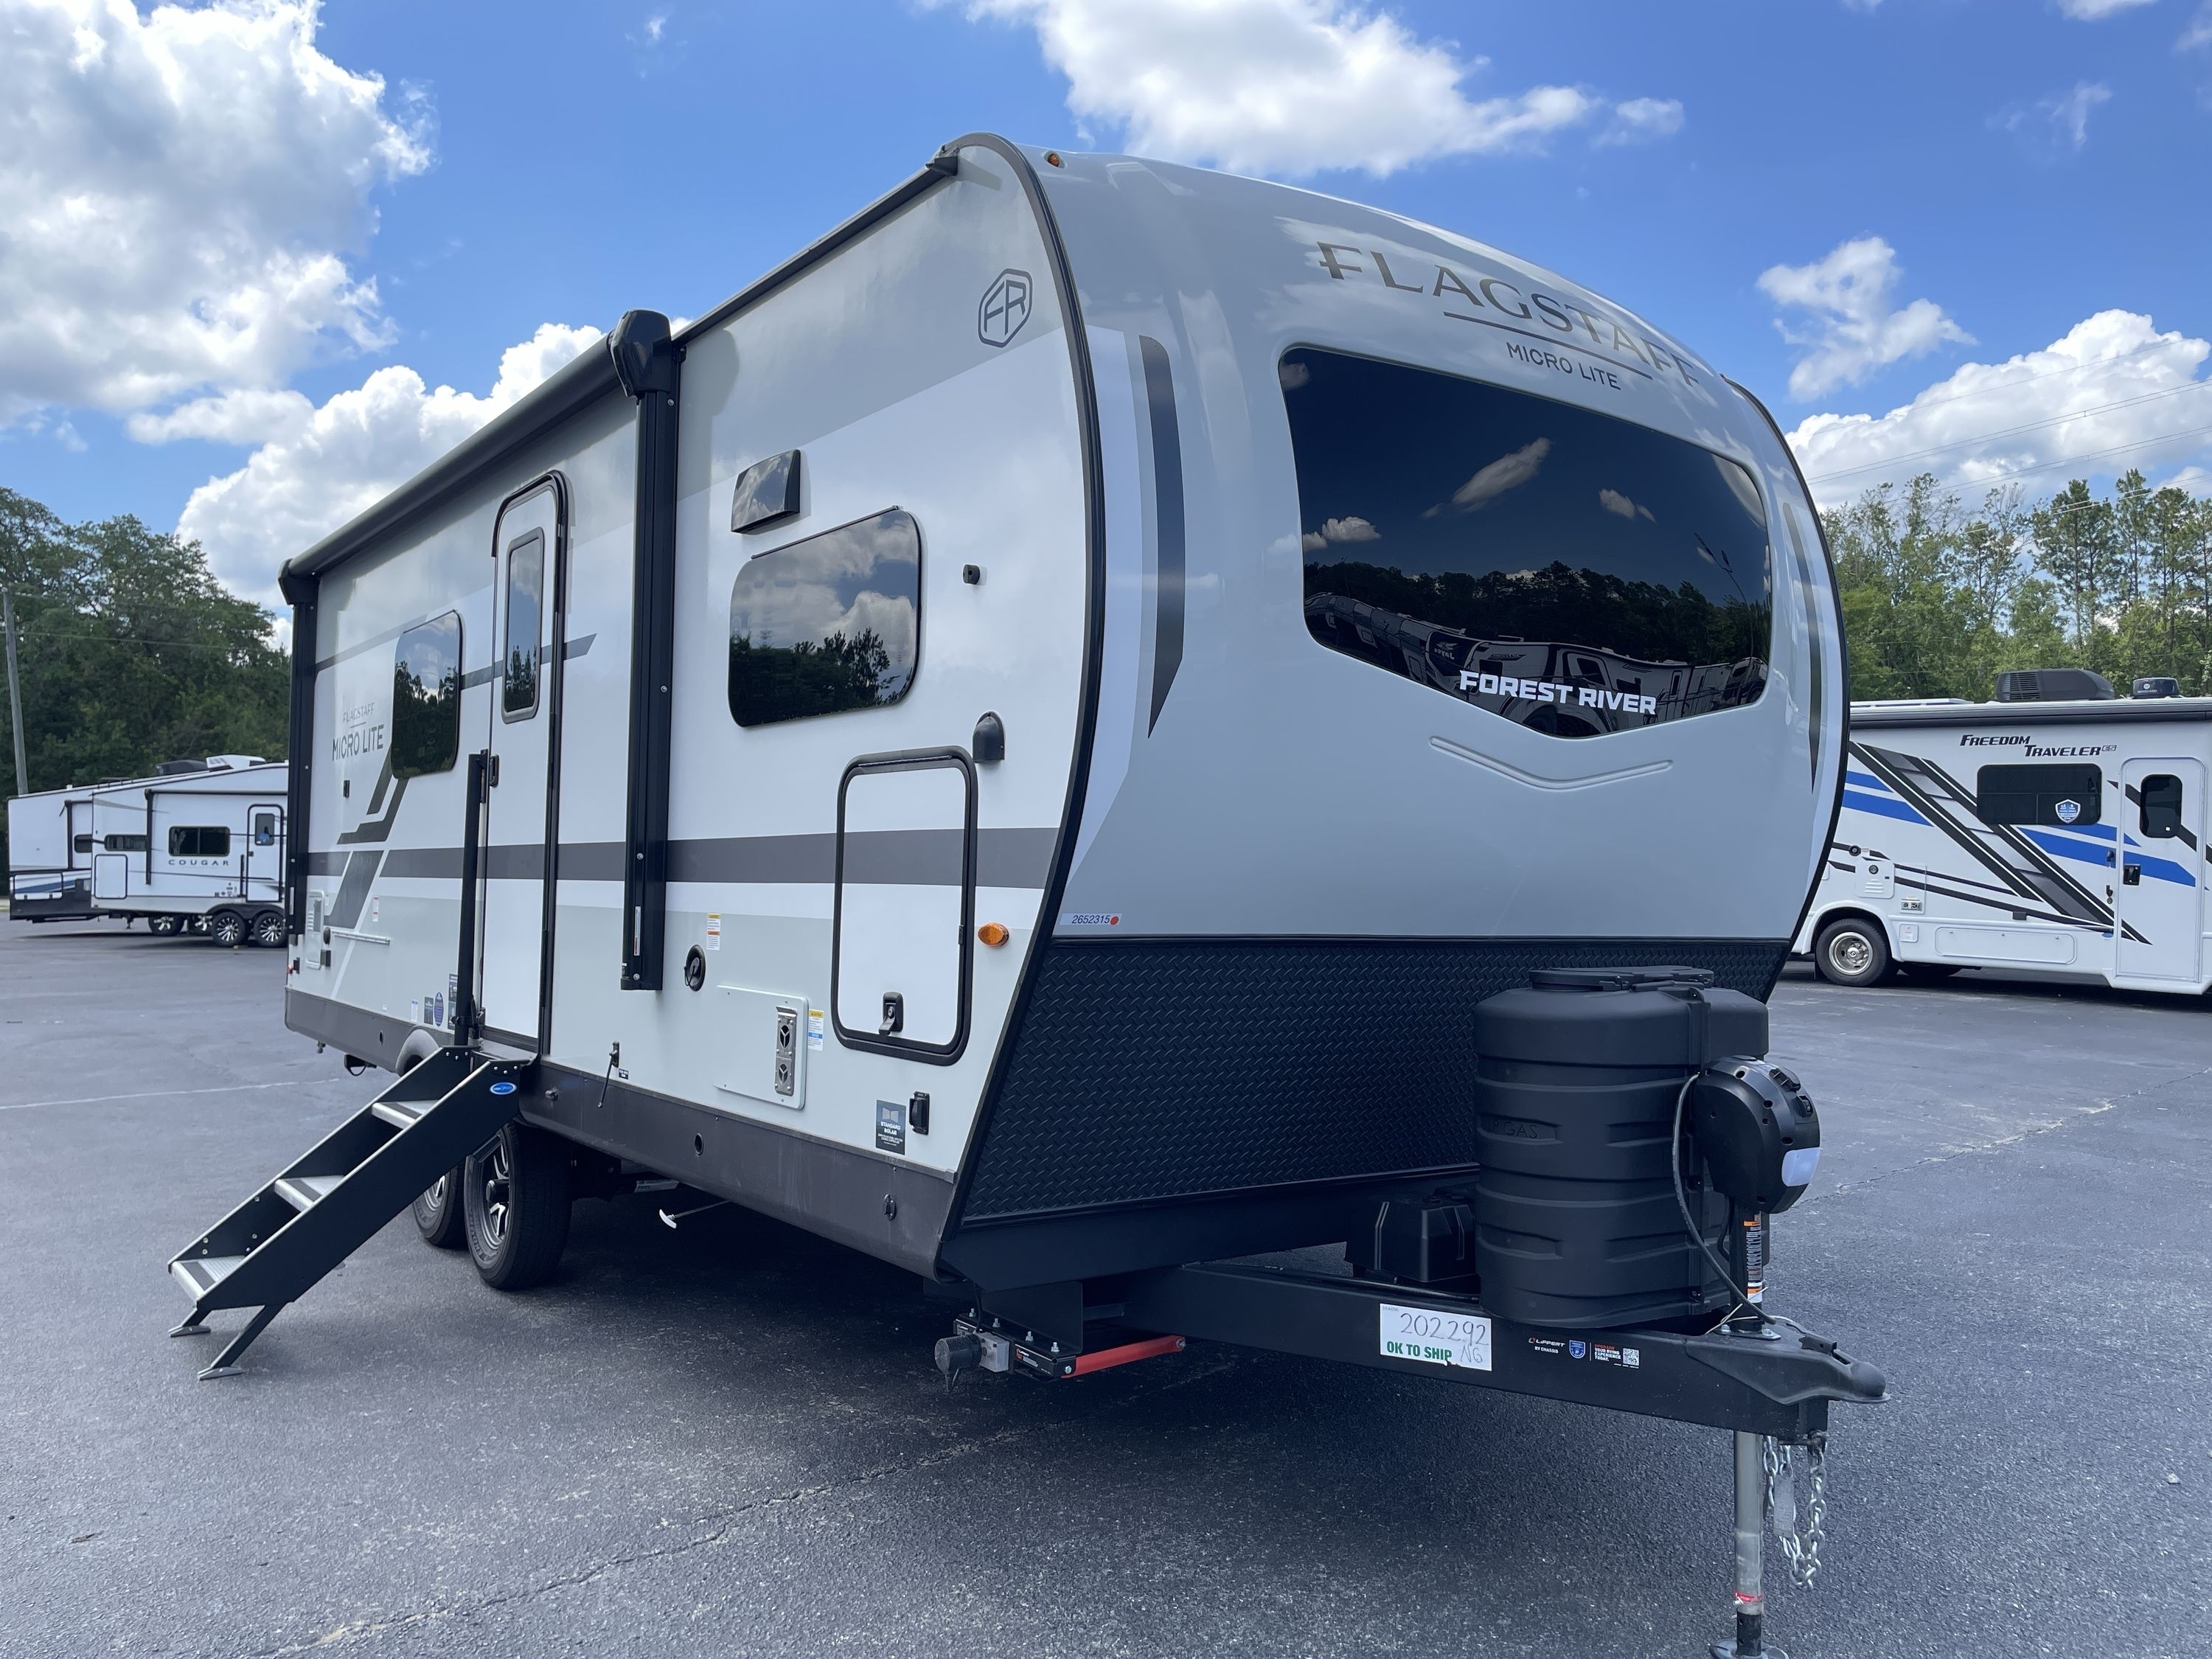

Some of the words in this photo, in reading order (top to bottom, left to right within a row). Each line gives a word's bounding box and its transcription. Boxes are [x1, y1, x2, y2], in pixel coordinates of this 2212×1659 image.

[1316, 241, 1700, 387] FLAGSTAFF
[1506, 341, 1573, 375] MICRO
[1579, 361, 1622, 391] LITE
[1459, 669, 1573, 704] FOREST
[1578, 686, 1657, 715] RIVER
[343, 702, 375, 723] FLAGSTAFF
[332, 731, 360, 762] MICRO
[363, 724, 384, 754] LITE
[1960, 734, 2031, 746] FREEDOM
[2024, 745, 2101, 757] TRAVELER
[1071, 914, 1111, 924] 2652315
[1503, 1121, 1538, 1139] GAS
[1400, 1312, 1489, 1346] 202292
[1386, 1340, 1403, 1354] OK
[1405, 1343, 1421, 1357] TO
[1424, 1346, 1453, 1361] SHIP
